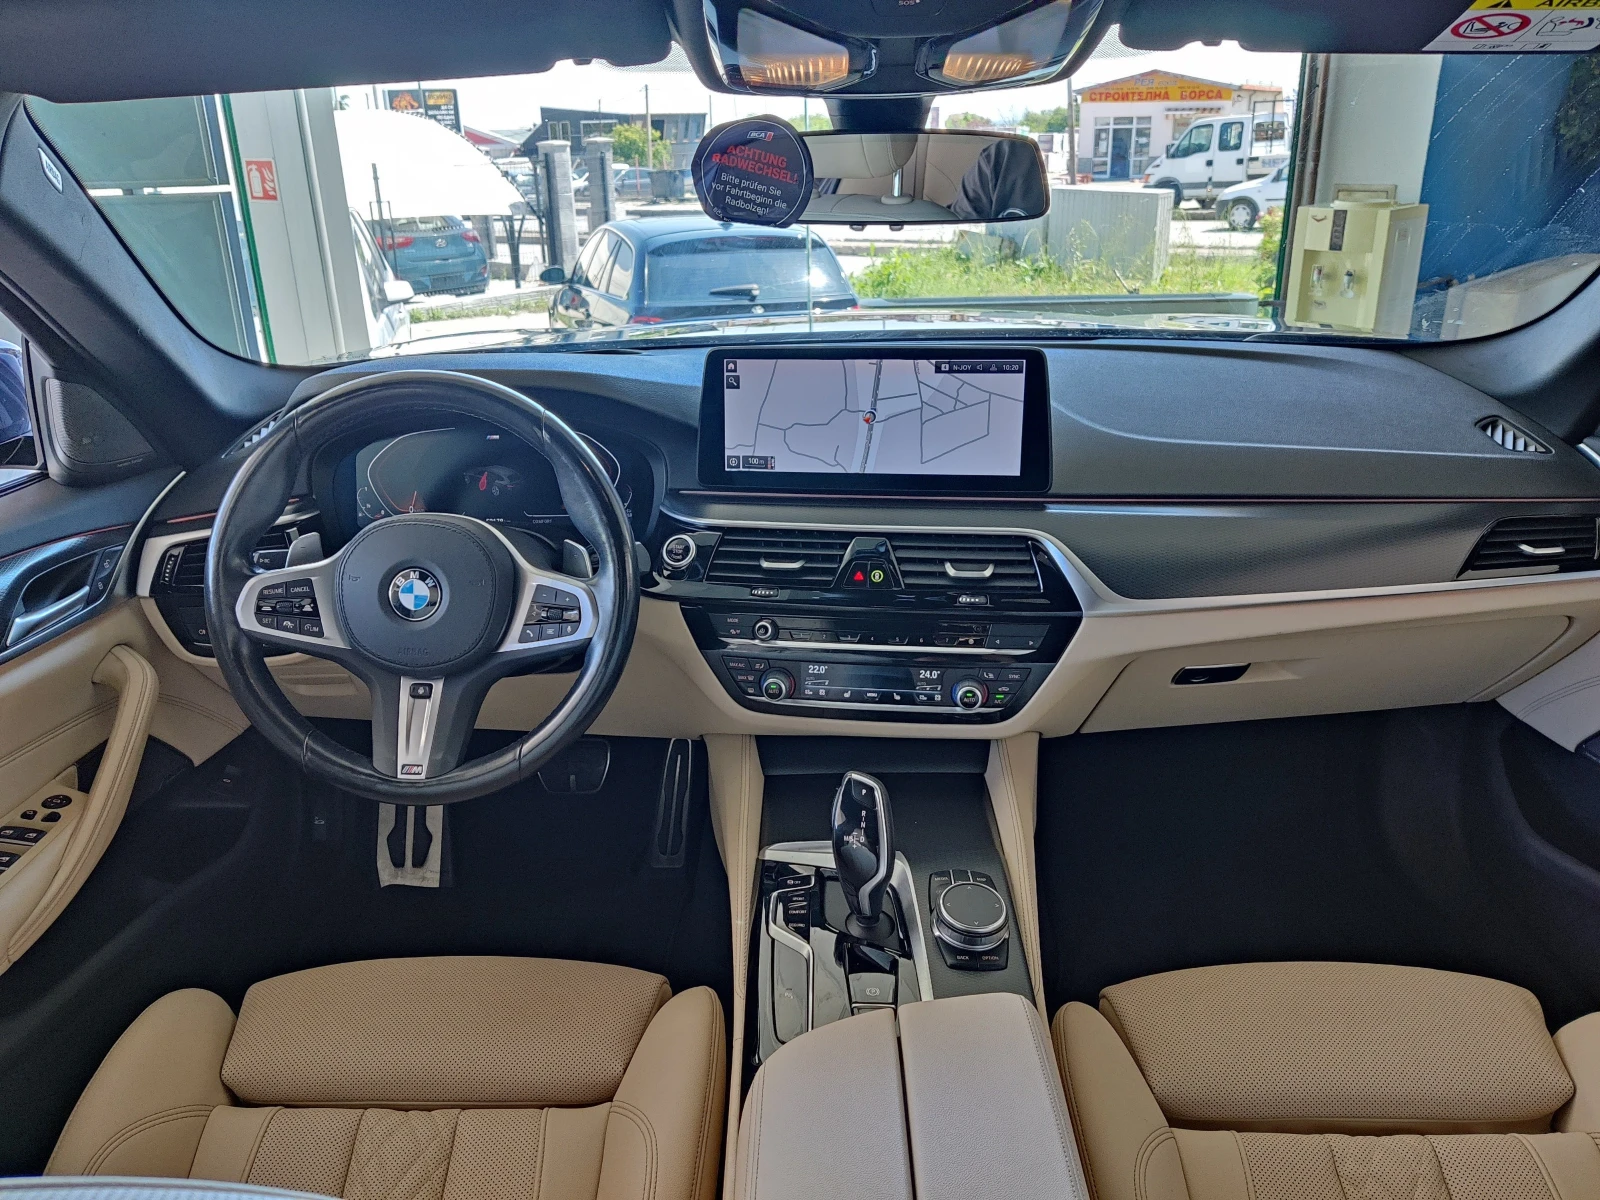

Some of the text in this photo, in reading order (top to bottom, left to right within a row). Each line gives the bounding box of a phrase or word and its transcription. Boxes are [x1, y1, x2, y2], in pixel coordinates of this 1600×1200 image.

[1535, 0, 1600, 8] AIRB
[1088, 91, 1171, 102] СТРОИТЕЛНА
[1180, 89, 1223, 101] БОРСА
[726, 145, 787, 168] ACHTUNG
[711, 153, 799, 184] RADWECHSEL!
[720, 172, 782, 197] Bitte prüfen Sie
[711, 182, 787, 209] vor Fahrtbeginn die
[725, 195, 770, 216] Radbolzen!
[748, 457, 759, 465] 100
[394, 570, 436, 588] BMW
[861, 788, 867, 796] P
[860, 821, 866, 829] N
